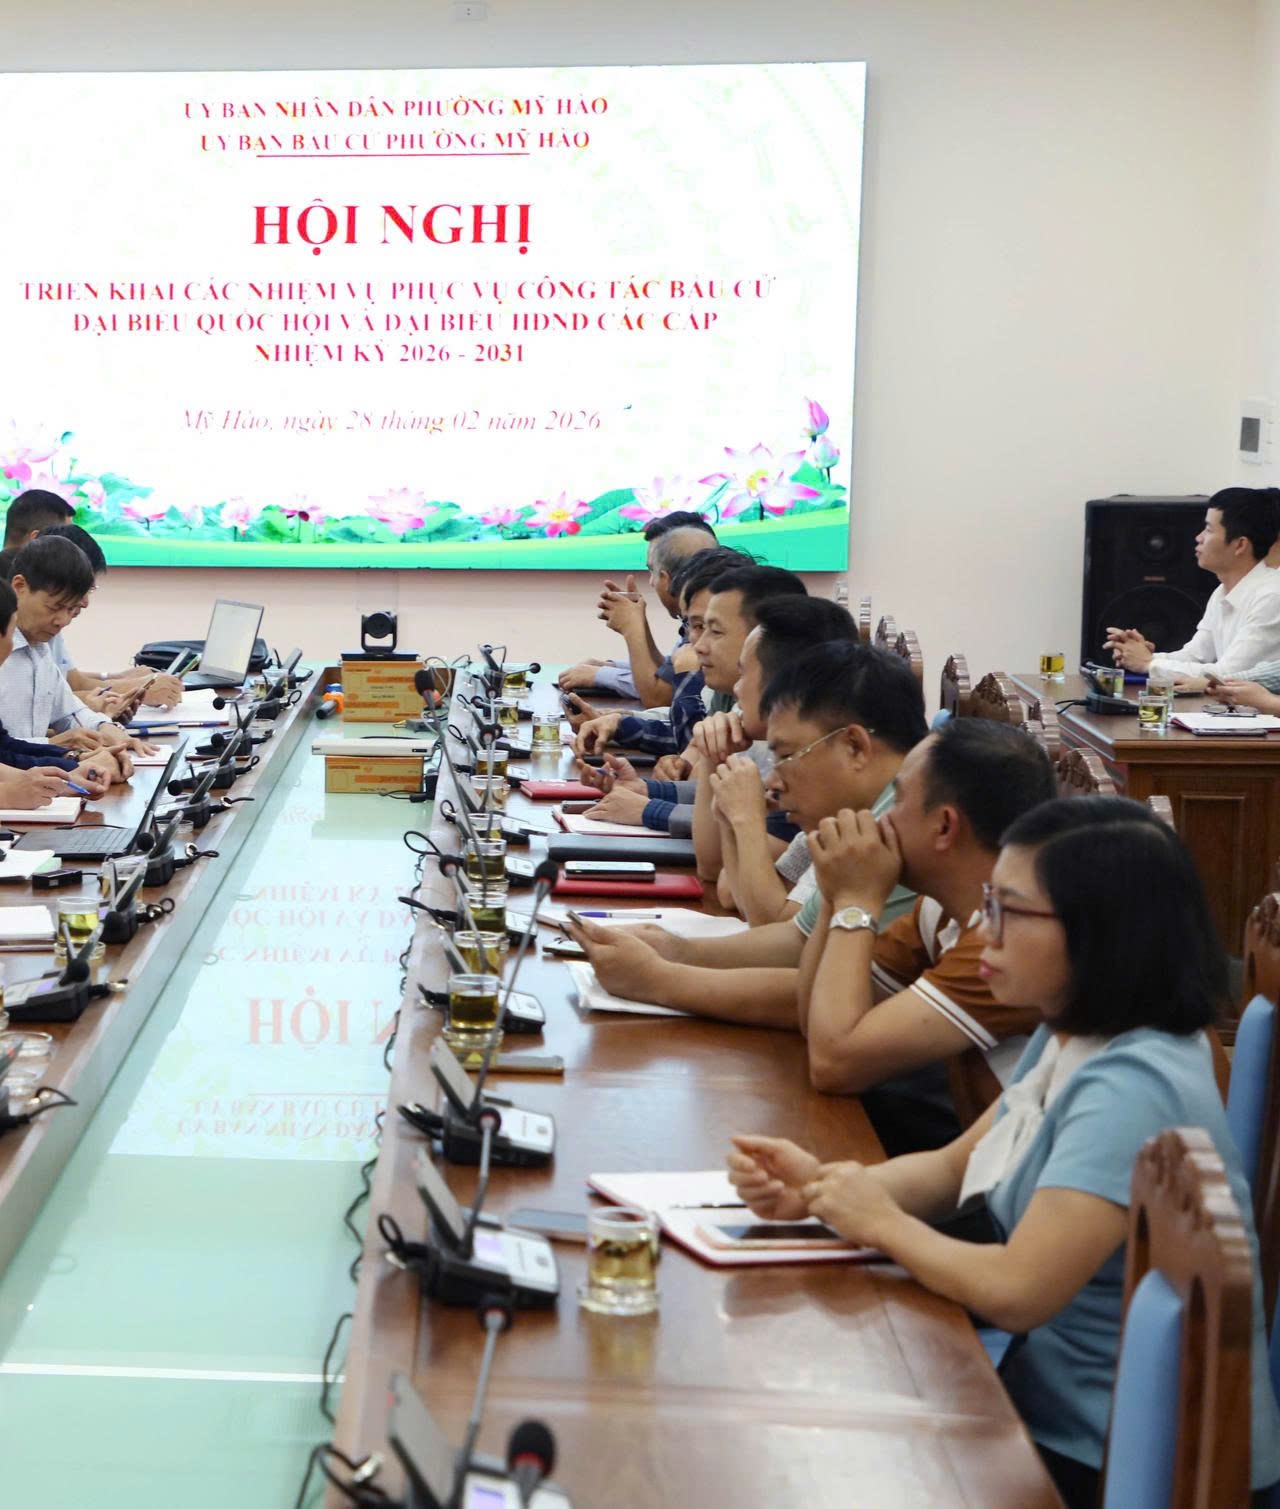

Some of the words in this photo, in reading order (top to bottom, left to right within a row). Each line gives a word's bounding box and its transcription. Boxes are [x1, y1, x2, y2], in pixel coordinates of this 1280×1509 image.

[222, 101, 267, 118] BAN
[275, 96, 340, 118] NHÂN
[347, 96, 396, 117] DÂN
[239, 134, 284, 151] BAN
[252, 197, 360, 256] HỘI
[380, 203, 533, 256] NGHỊ
[110, 282, 174, 301] KHAI
[346, 282, 381, 305] VỤ
[392, 282, 464, 305] PHỤC
[472, 281, 508, 305] VỤ
[517, 274, 596, 300] CÔNG
[606, 274, 661, 299] TÁC
[399, 343, 451, 362] 2026
[474, 343, 523, 362] 2031
[345, 409, 373, 431] 28
[452, 410, 479, 431] 02
[543, 409, 601, 432] 2026
